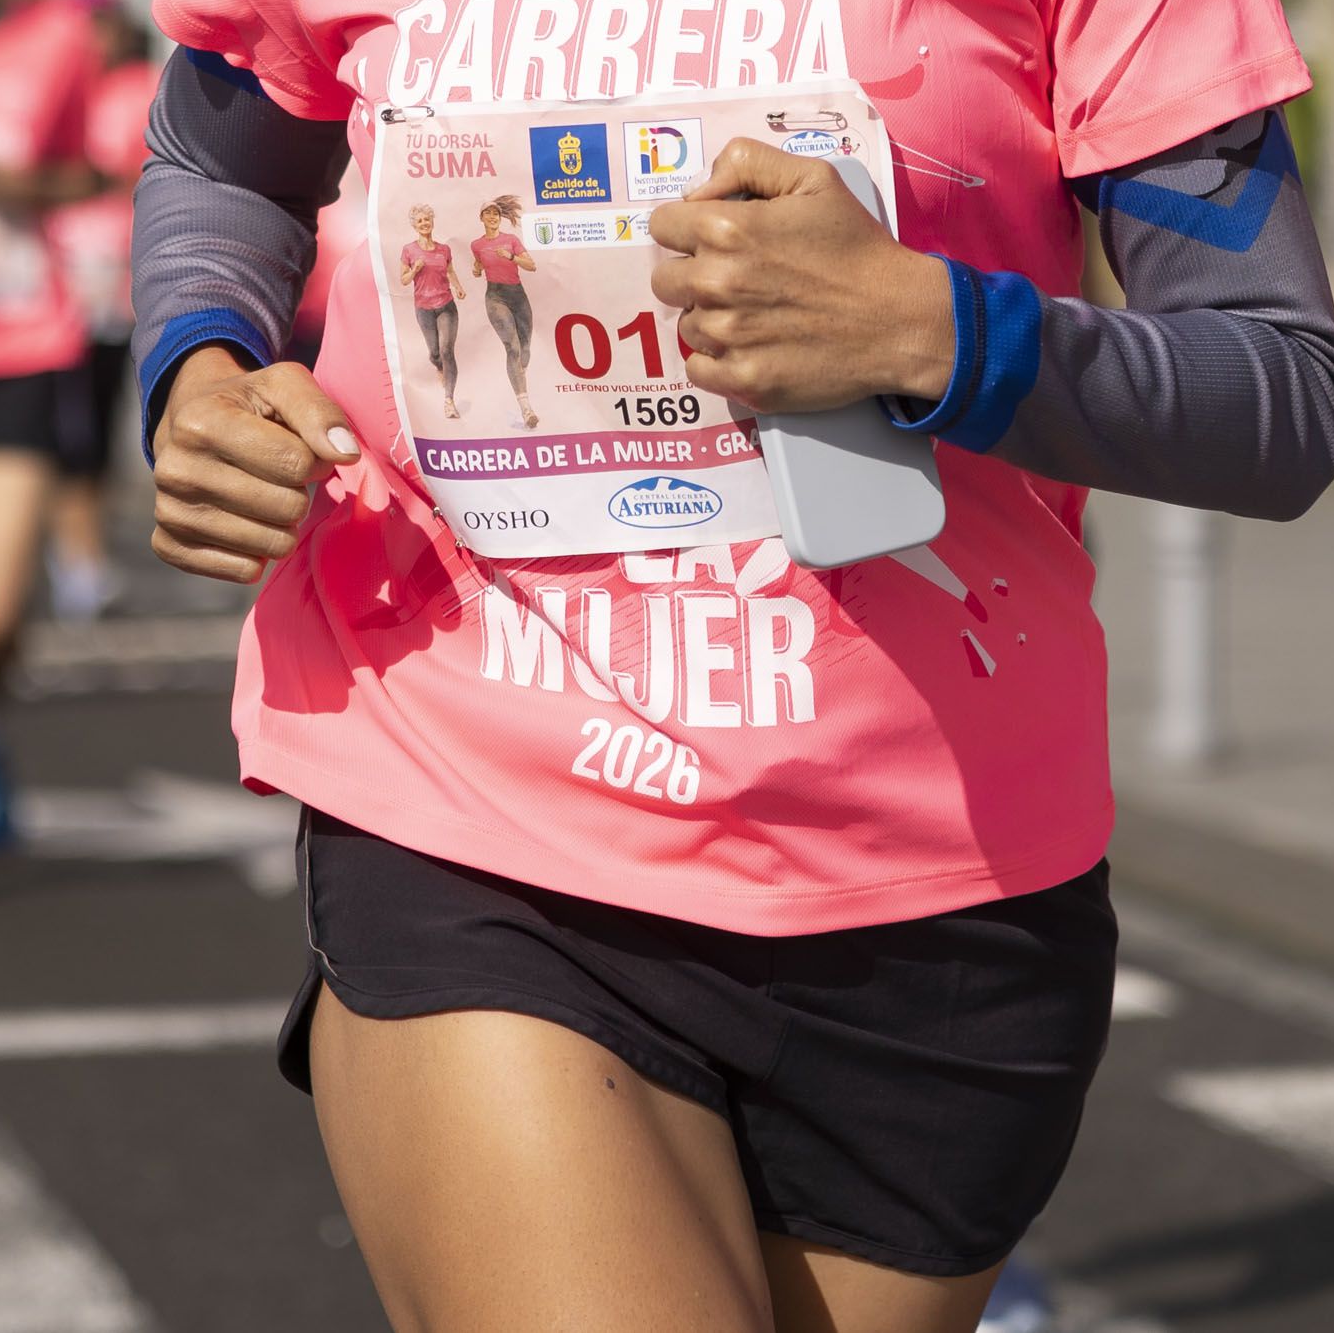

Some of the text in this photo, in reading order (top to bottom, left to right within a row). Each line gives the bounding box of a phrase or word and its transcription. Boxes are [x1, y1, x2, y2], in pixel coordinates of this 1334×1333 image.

[407, 133, 494, 149] TU DORSAL
[787, 142, 836, 153] ASTURIANA
[407, 151, 497, 179] SUMA
[544, 177, 598, 190] Cabildo de
[649, 184, 684, 194] DEPORT
[541, 187, 606, 200] Gran Canaria
[557, 222, 605, 230] Ayuntamiento
[555, 311, 694, 380] 01
[555, 383, 610, 393] TELÉFONO
[611, 384, 667, 393] VIOLENCIA
[670, 382, 684, 391] DE
[614, 394, 700, 426] 1569
[426, 425, 760, 473] CARRERA DE LA MUJER GRA
[633, 493, 669, 501] CENTRAL
[618, 497, 715, 518] ASTURIANA
[463, 509, 549, 532] OYSHO
[479, 586, 816, 727] MUJER
[571, 717, 701, 805] 2026
